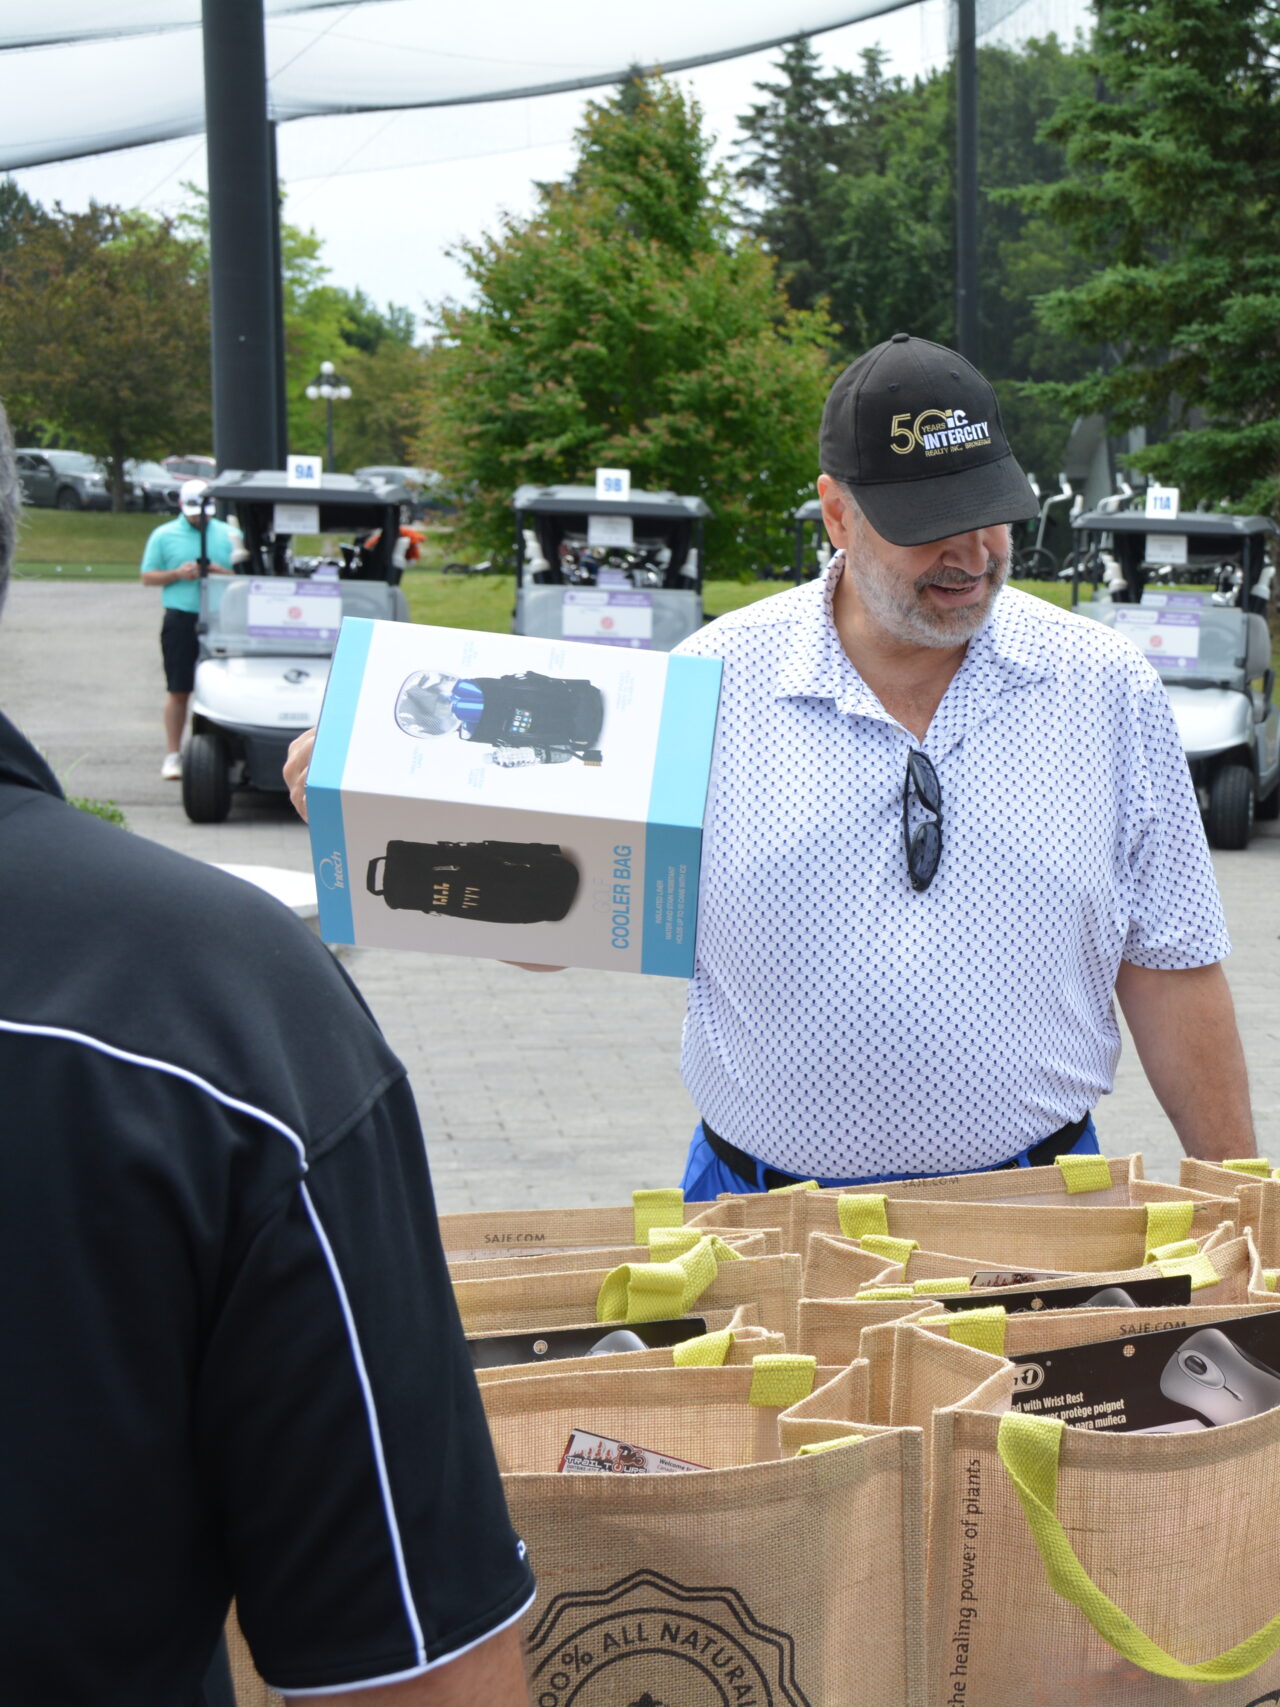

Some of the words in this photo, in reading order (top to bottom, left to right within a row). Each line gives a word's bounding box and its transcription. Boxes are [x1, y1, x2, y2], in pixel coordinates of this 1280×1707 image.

[921, 422, 946, 433] YEARS
[923, 421, 989, 450] INTERCITY
[925, 448, 949, 457] REALTY
[295, 464, 314, 480] 9A
[604, 477, 622, 492] 9B
[332, 851, 344, 888] Intech
[613, 845, 632, 880] BAG
[611, 884, 631, 949] COOLER
[484, 1233, 545, 1244] SAJECOM
[1011, 1402, 1022, 1412] ad
[1023, 1398, 1042, 1412] with
[1043, 1395, 1065, 1409] Wrist
[1066, 1391, 1084, 1404] Rest
[1060, 1405, 1092, 1420] protège
[1093, 1398, 1125, 1415] poignet
[1095, 1414, 1127, 1428] muñeca
[566, 1456, 602, 1468] TRAIL
[659, 1458, 685, 1470] Welcome
[962, 1458, 984, 1515] plants
[962, 1519, 978, 1539] of
[960, 1543, 978, 1601] power
[950, 1607, 978, 1678] healing
[539, 1645, 593, 1707] 00%
[602, 1621, 649, 1651] ALL
[947, 1681, 966, 1707] he
